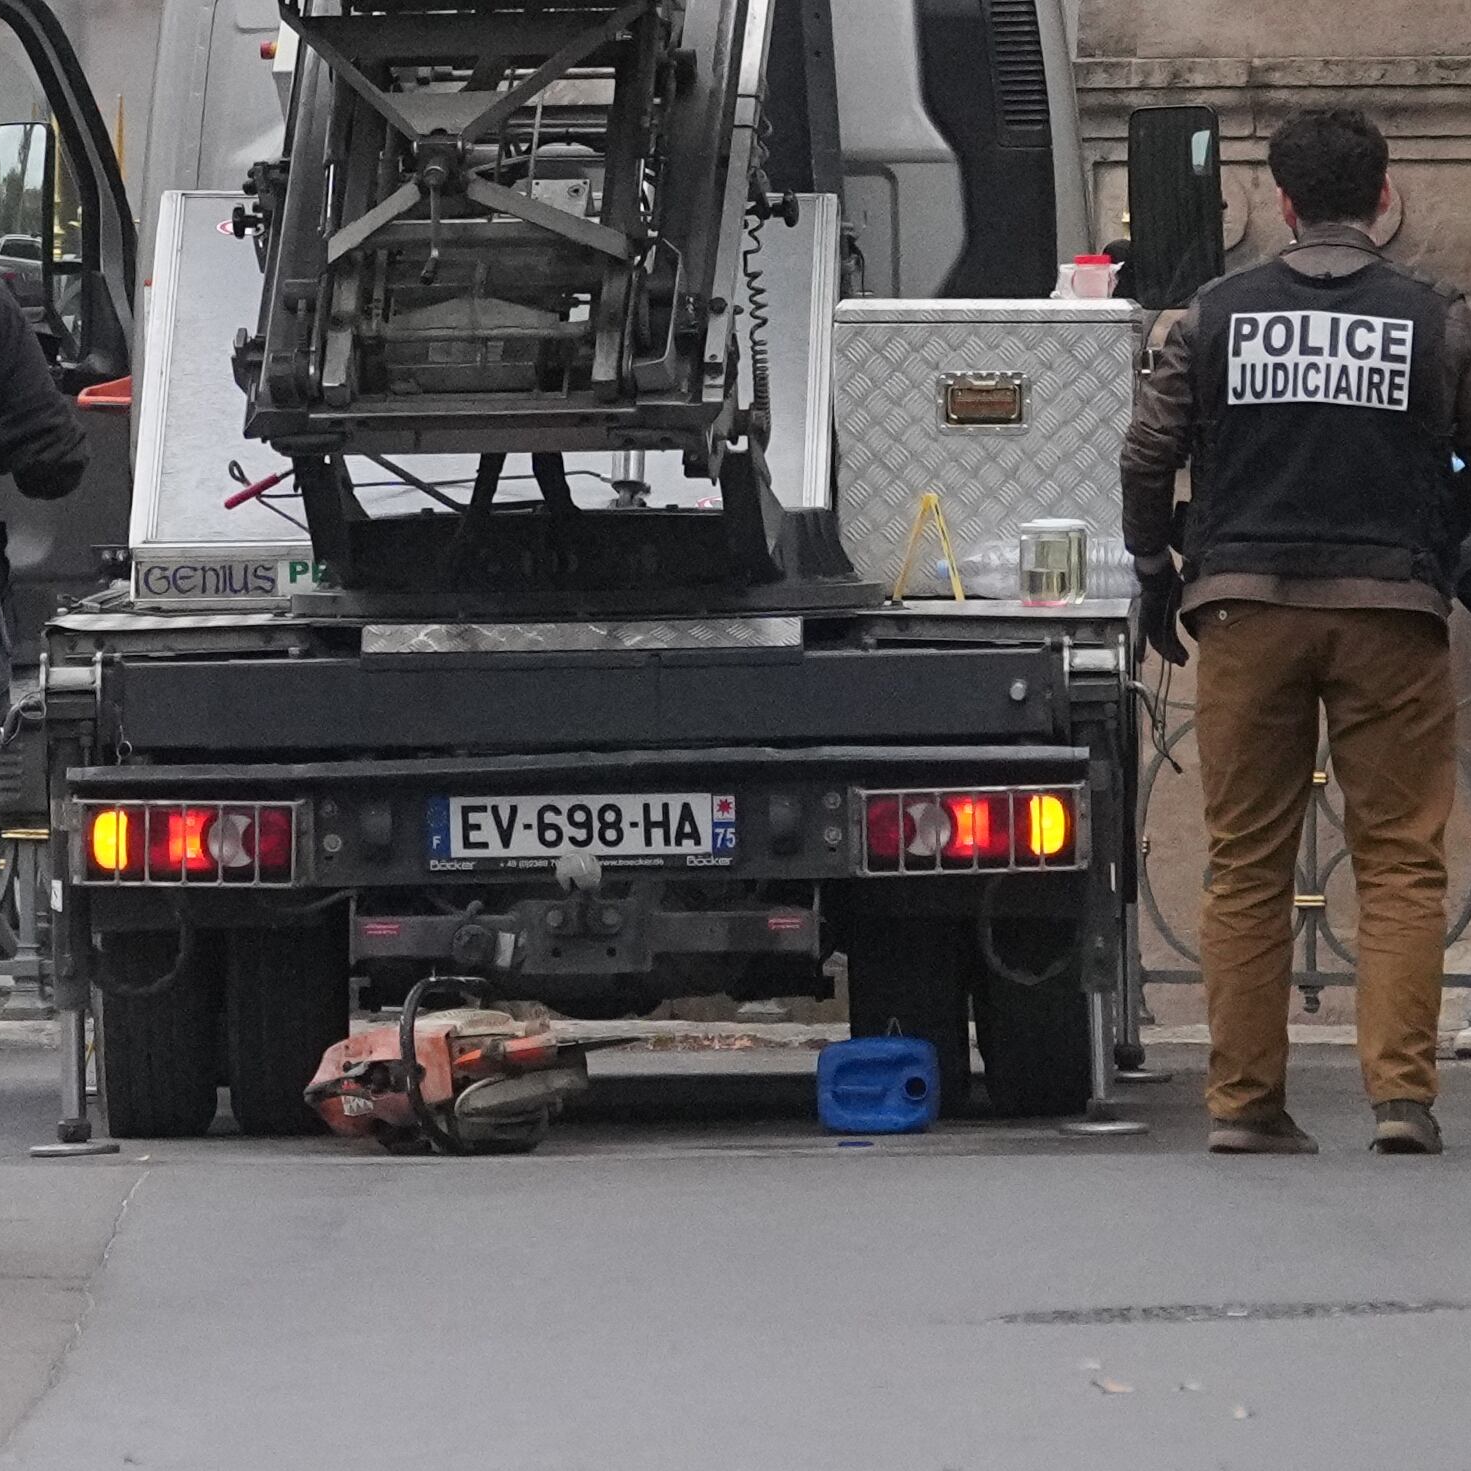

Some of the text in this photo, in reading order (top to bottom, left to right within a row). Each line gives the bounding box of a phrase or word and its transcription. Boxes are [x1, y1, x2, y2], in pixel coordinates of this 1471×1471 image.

[1231, 314, 1409, 365] POLICE
[1231, 362, 1406, 406] JUDICIAIRE
[143, 563, 276, 595] GENIUS
[431, 802, 736, 850] F EV-698-HA 75
[429, 859, 477, 871] Böcker
[686, 855, 733, 867] Böcker
